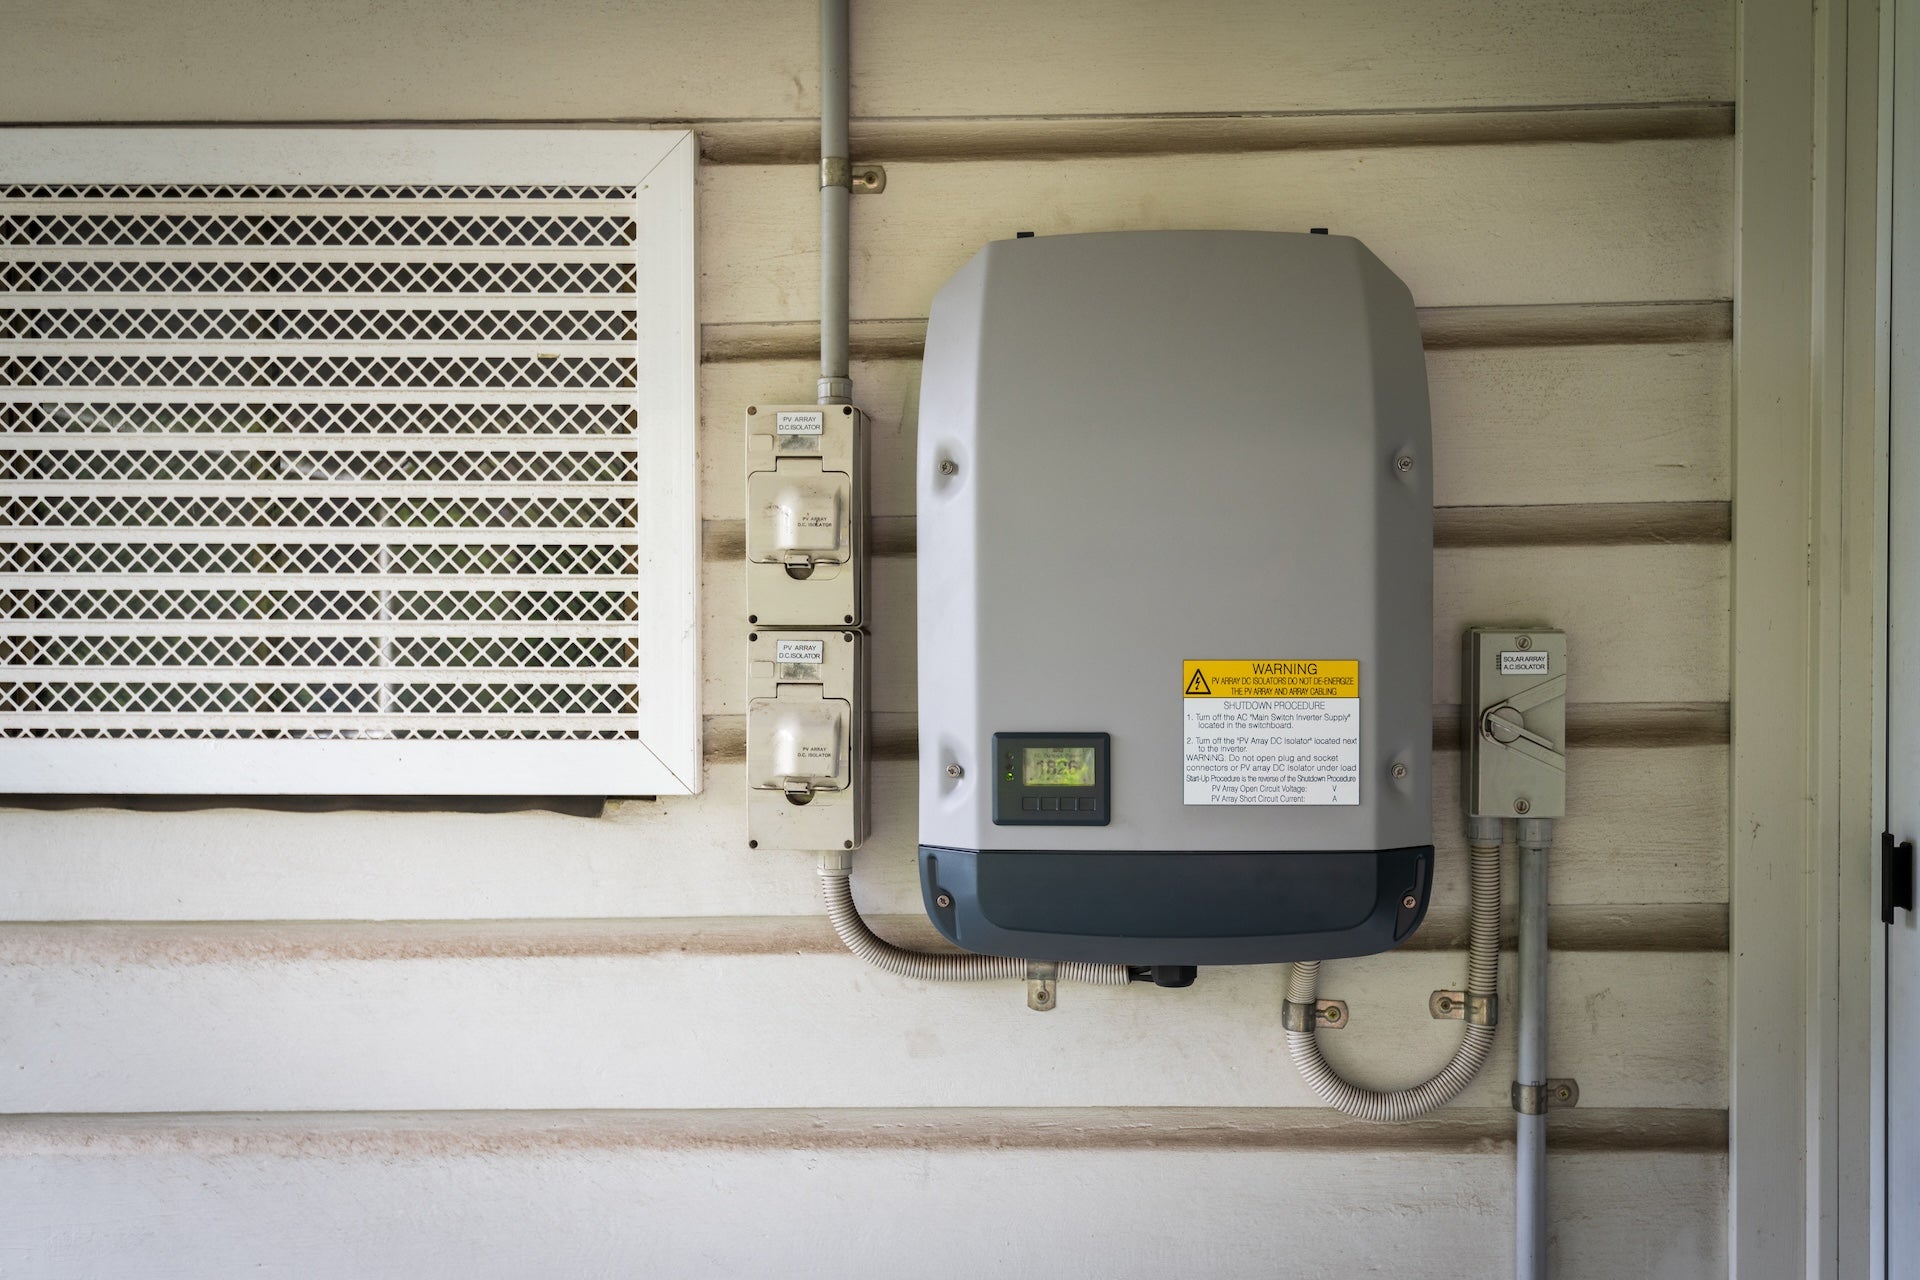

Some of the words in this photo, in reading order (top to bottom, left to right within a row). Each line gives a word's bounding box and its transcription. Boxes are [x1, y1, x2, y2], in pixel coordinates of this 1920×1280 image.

[1252, 663, 1318, 675] WARNING
[1212, 677, 1220, 685] PV
[1220, 677, 1240, 685] ARRAY
[1242, 677, 1250, 685] DC
[1252, 677, 1286, 685] ISOLATORS
[1288, 677, 1298, 685] DO
[1298, 677, 1312, 685] NOT
[1224, 702, 1272, 710] SHUTDOWN
[1274, 702, 1325, 710] PROCEDURE
[1250, 737, 1268, 746] Array
[1278, 754, 1294, 762] plug
[1222, 785, 1238, 793] Array
[1240, 785, 1258, 793] Open
[1282, 785, 1307, 794] Voltage:
[1222, 795, 1238, 803] Array
